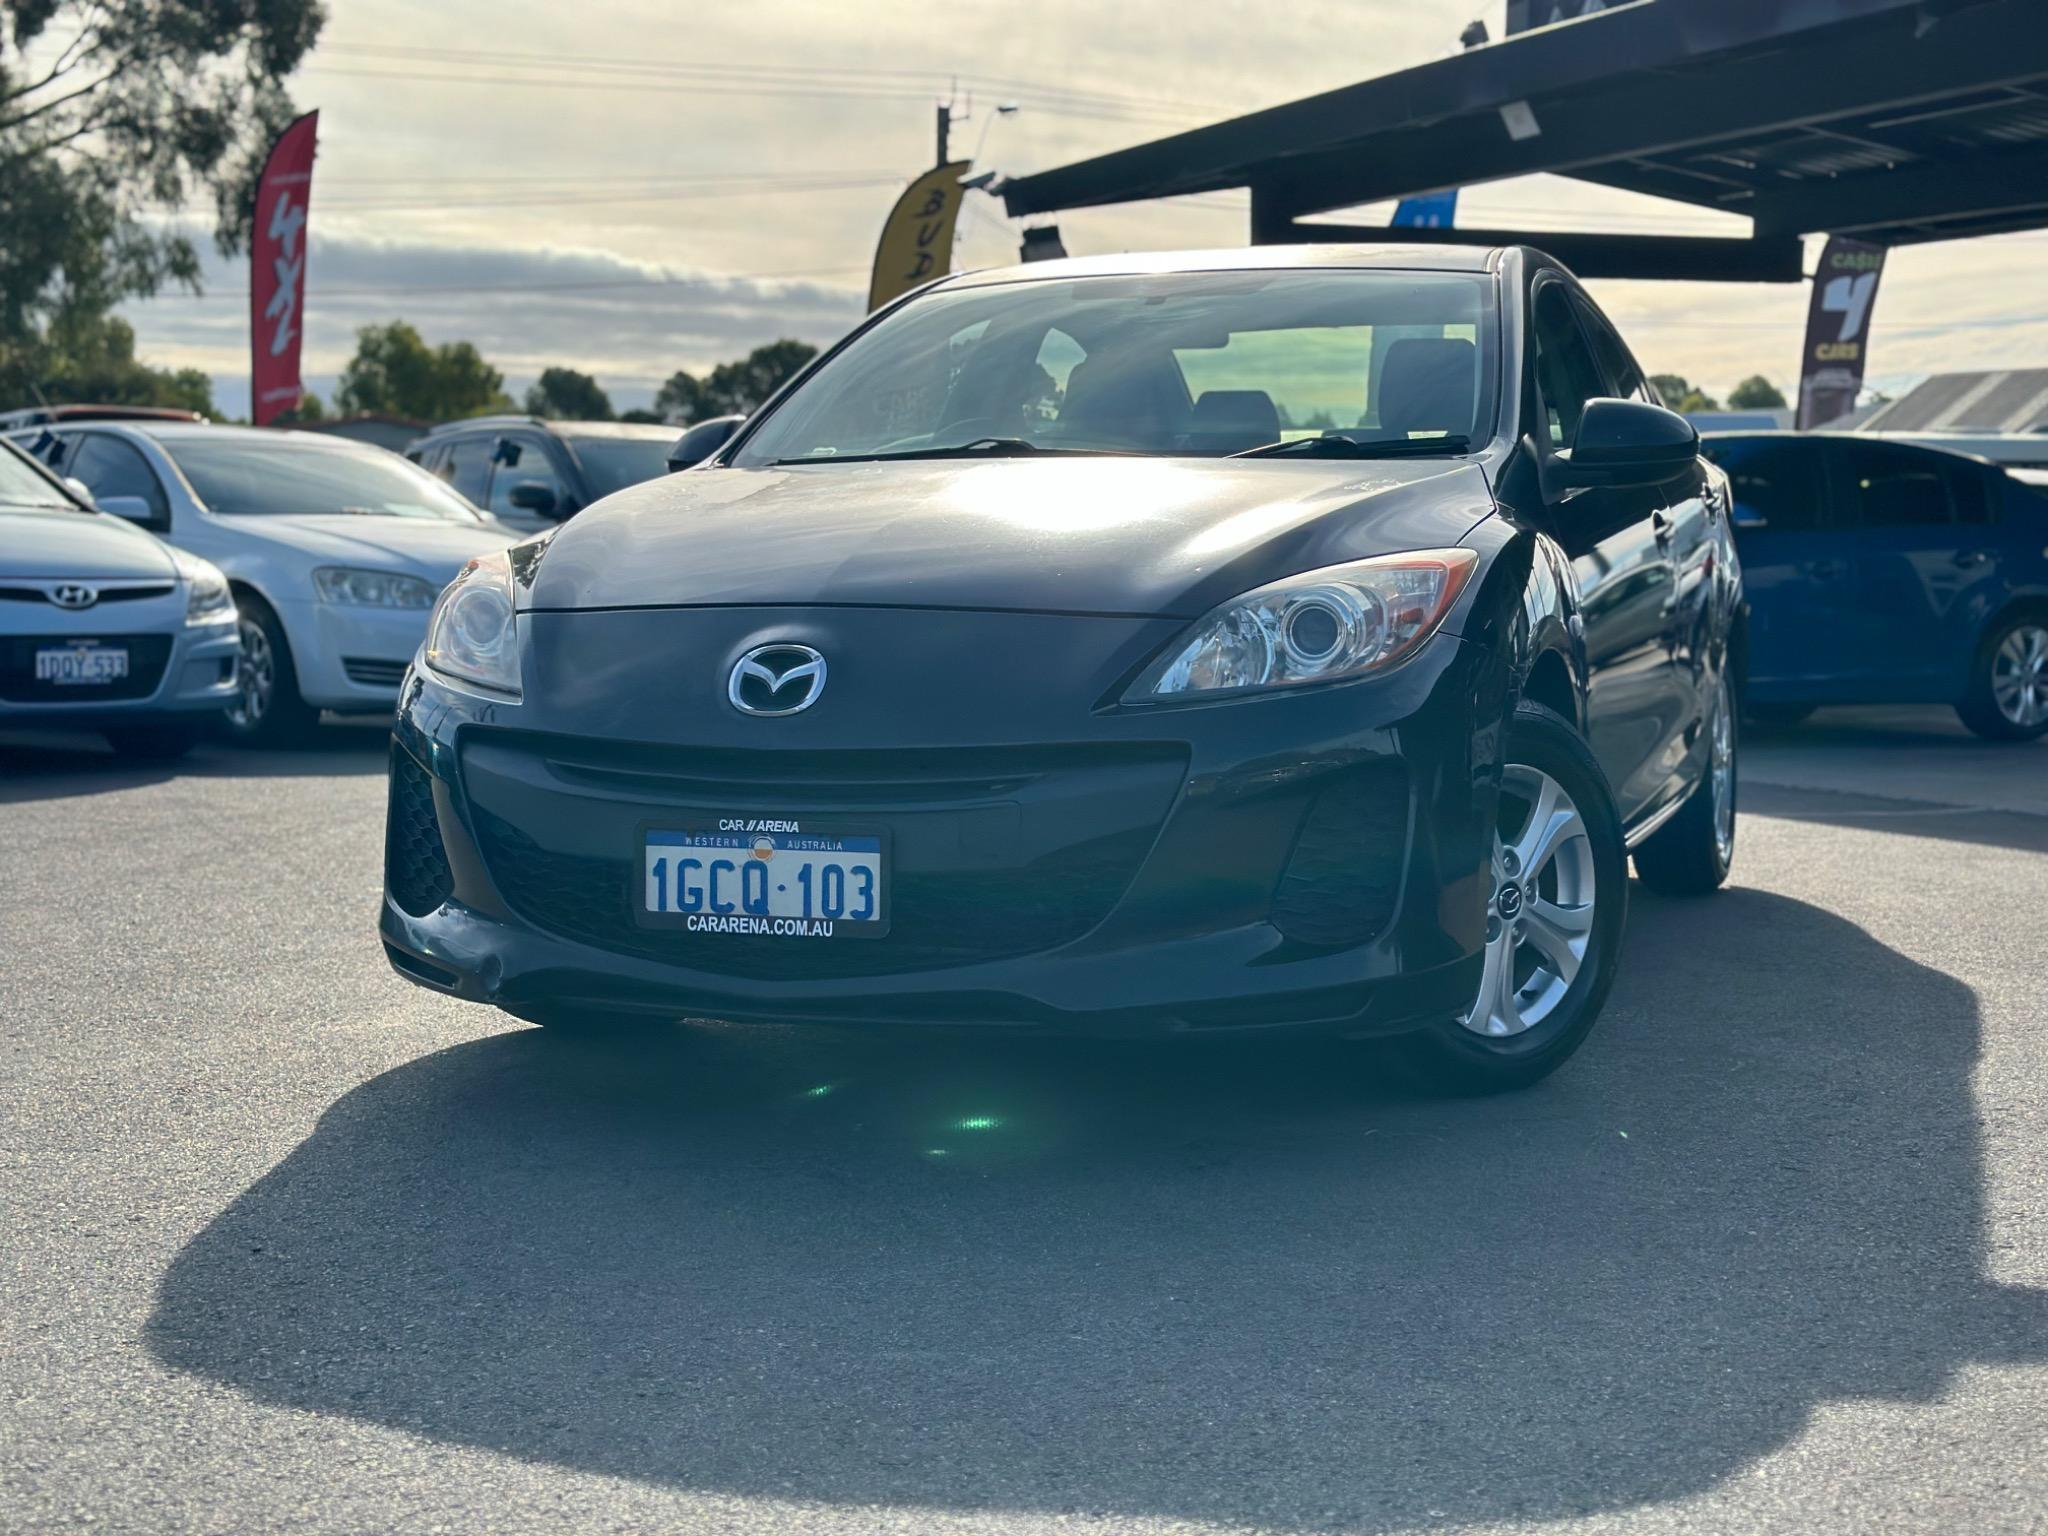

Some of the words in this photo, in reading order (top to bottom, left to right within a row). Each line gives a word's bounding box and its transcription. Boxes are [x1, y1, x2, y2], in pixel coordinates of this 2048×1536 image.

[1821, 271, 1878, 342] 4
[685, 836, 739, 848] WESTERN
[787, 840, 843, 851] AUSTRALIA
[687, 915, 834, 937] CARARENA.COM.AU
